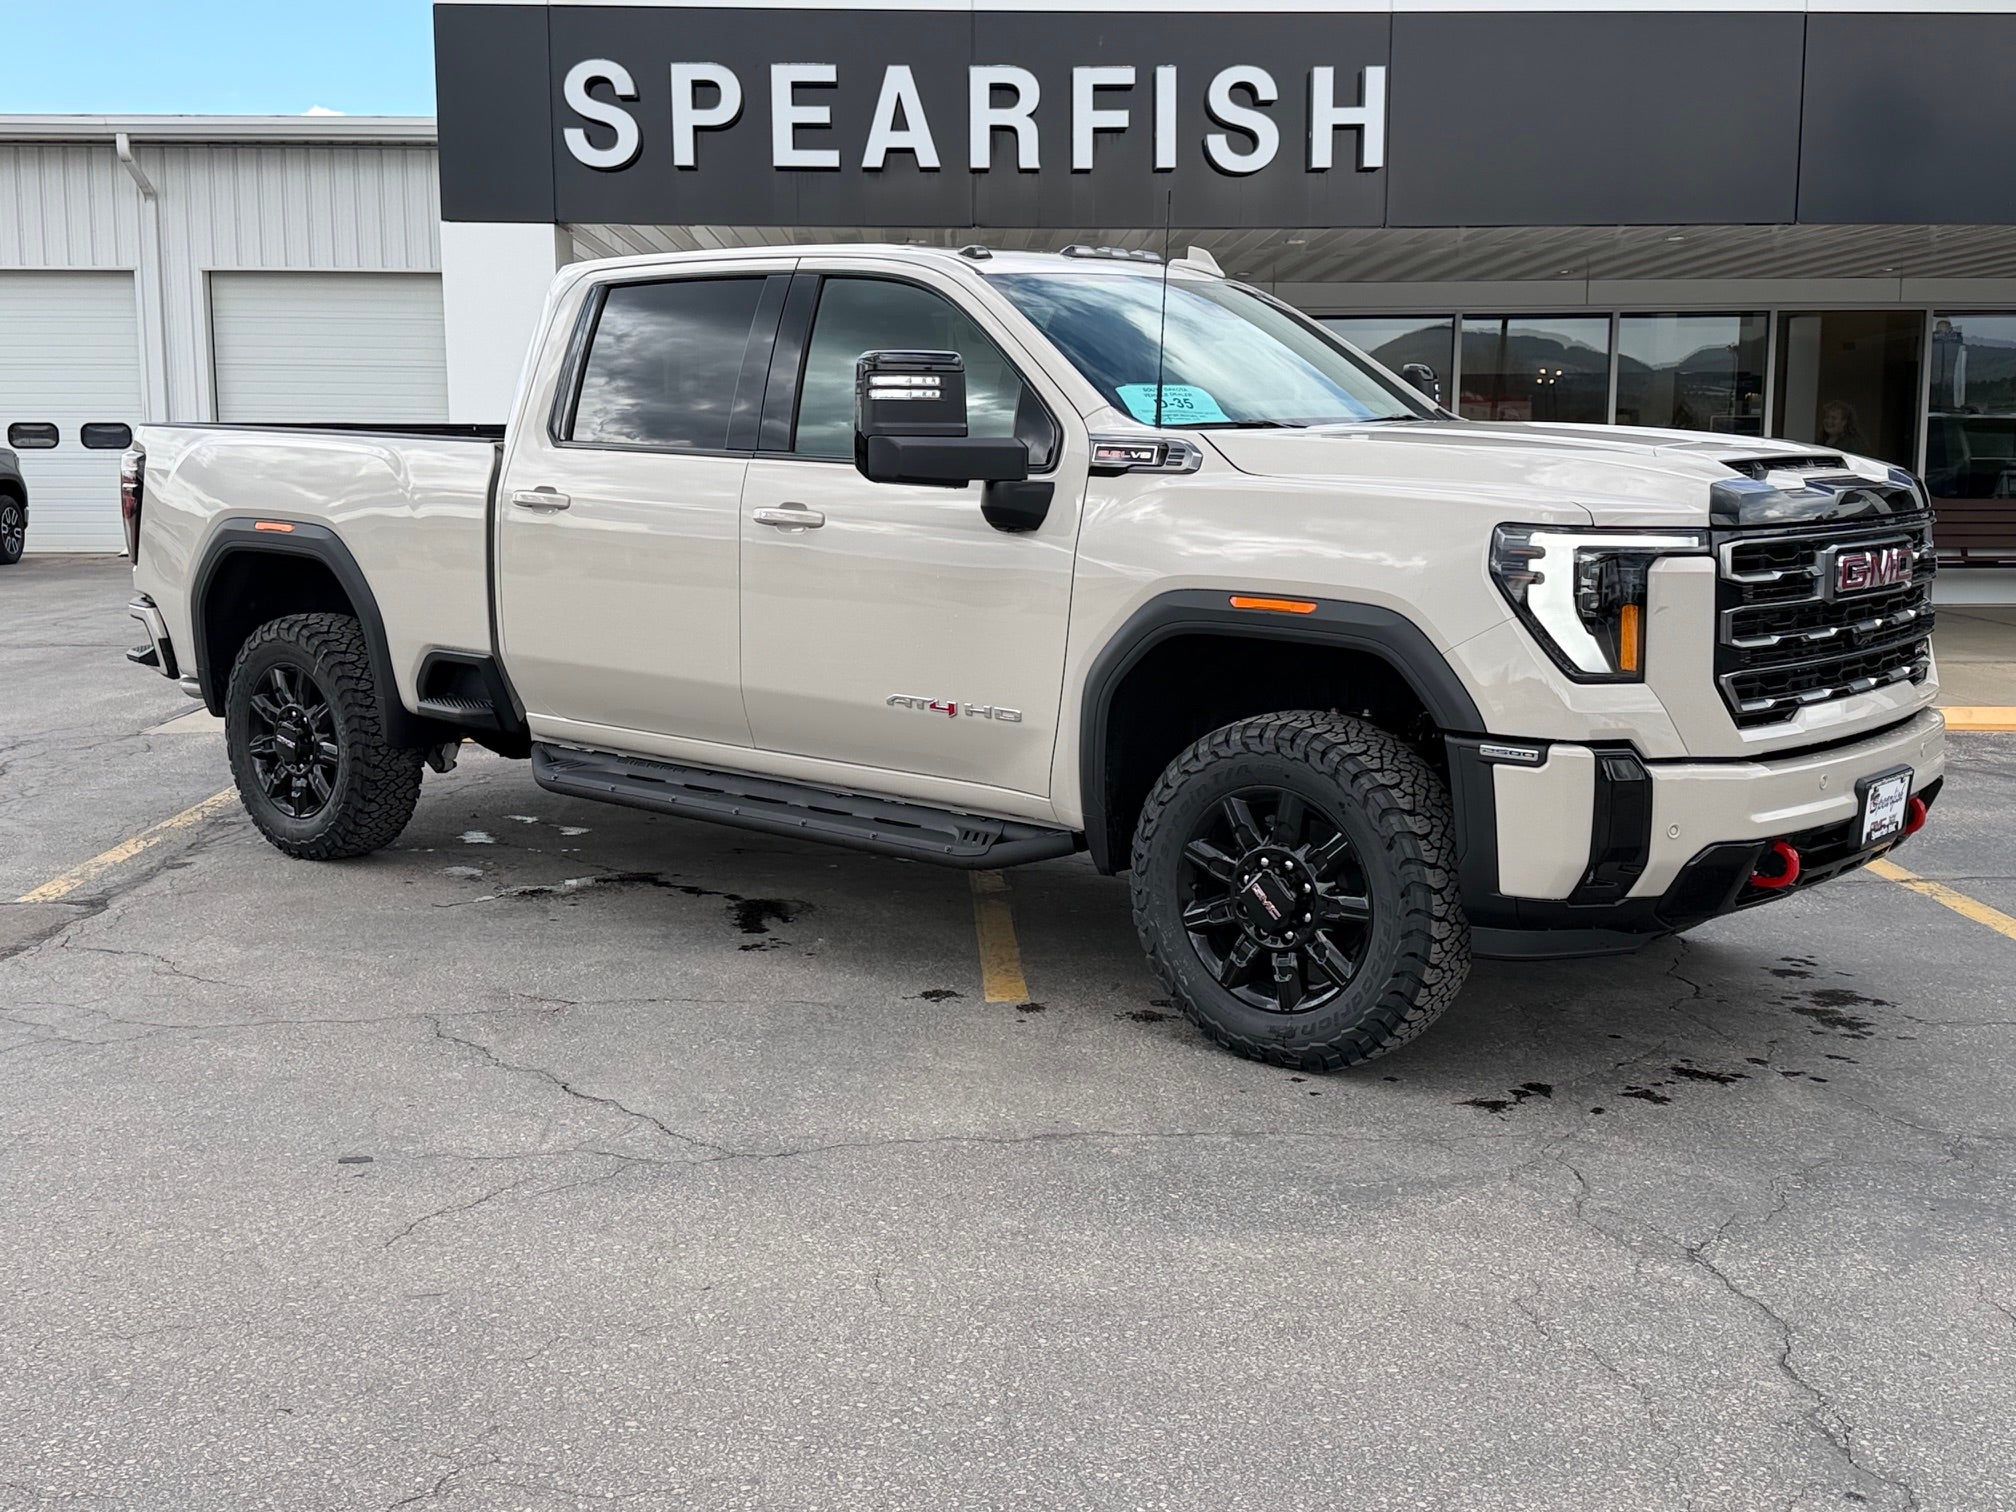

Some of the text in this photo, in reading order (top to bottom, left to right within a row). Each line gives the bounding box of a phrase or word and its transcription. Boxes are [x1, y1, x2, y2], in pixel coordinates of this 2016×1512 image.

[562, 58, 1387, 175] SPEARFISH
[1837, 547, 1913, 592] GMC
[964, 702, 1022, 723] HD
[1250, 882, 1282, 921] GMC
